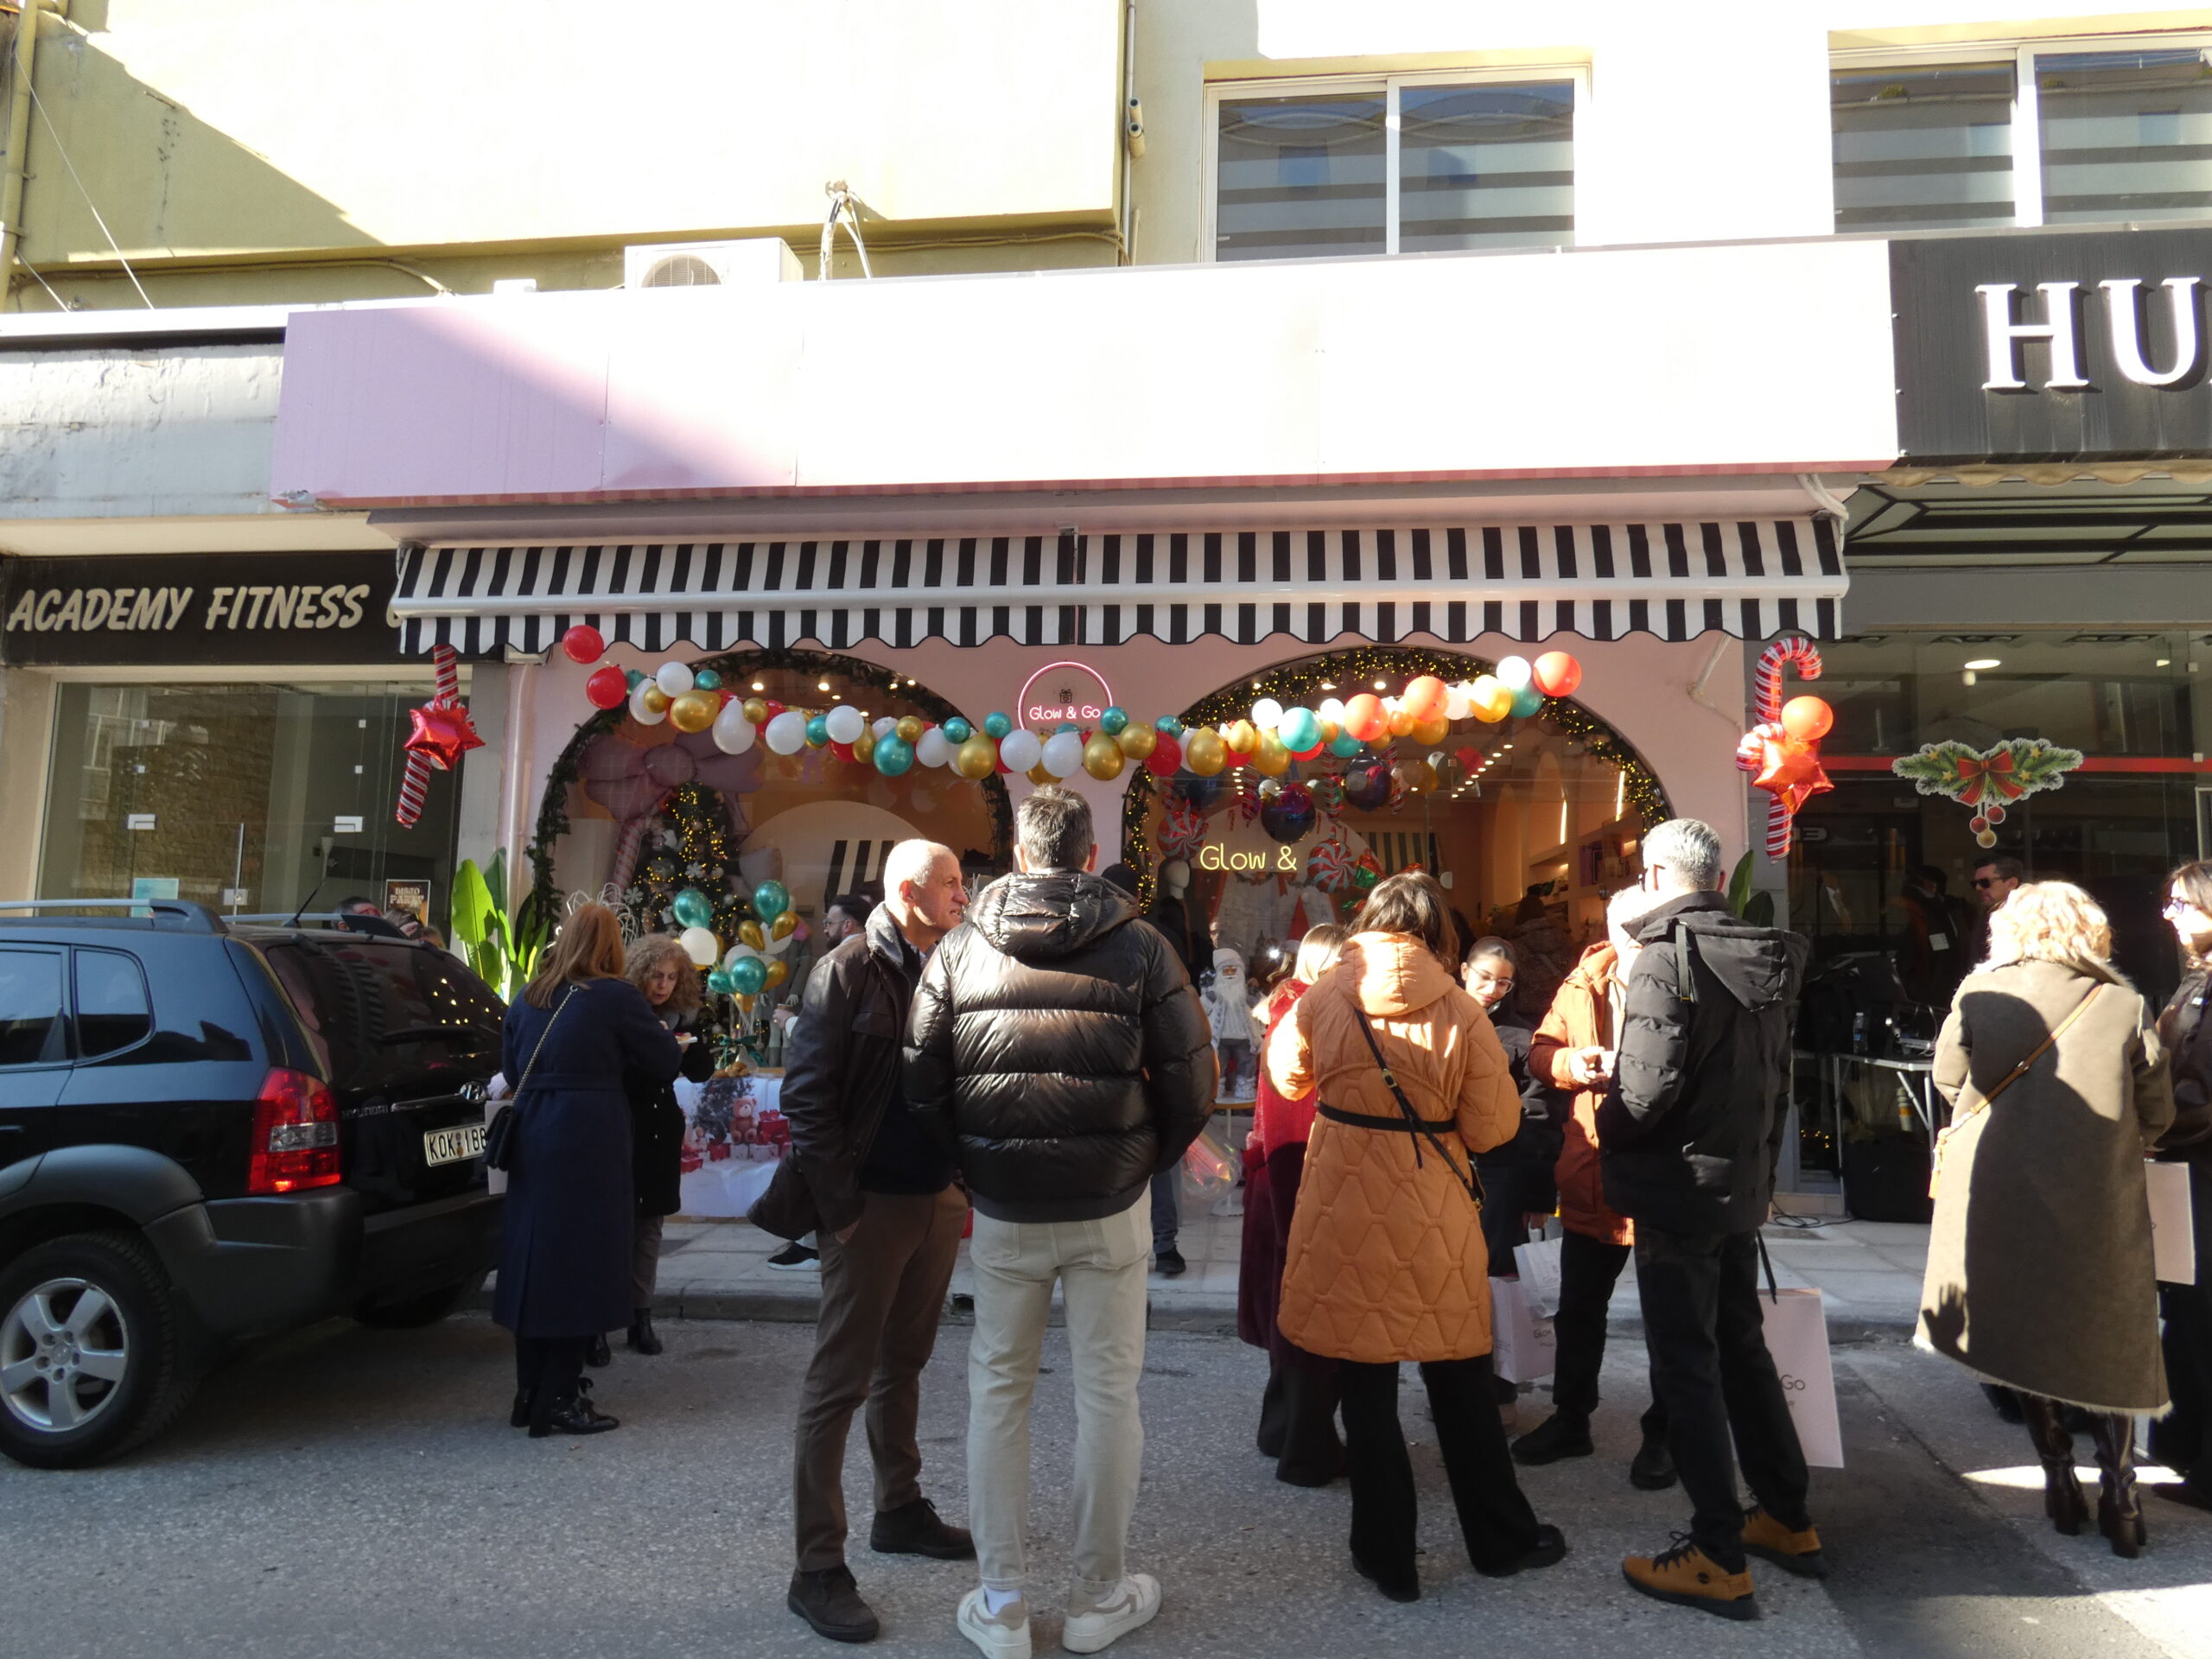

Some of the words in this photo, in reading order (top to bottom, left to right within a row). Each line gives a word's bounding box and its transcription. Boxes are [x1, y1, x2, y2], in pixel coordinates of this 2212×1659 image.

[1974, 276, 2212, 390] HU
[6, 587, 194, 632] ACADEMY
[205, 584, 371, 630] FITNESS
[1029, 705, 1062, 720] Glow
[1066, 706, 1077, 719] &
[1081, 705, 1101, 718] Go
[1199, 842, 1266, 871] Glow
[1277, 845, 1297, 871] &
[429, 1133, 456, 1160] KOK
[465, 1128, 487, 1153] 188
[1780, 1374, 1805, 1390] Go
